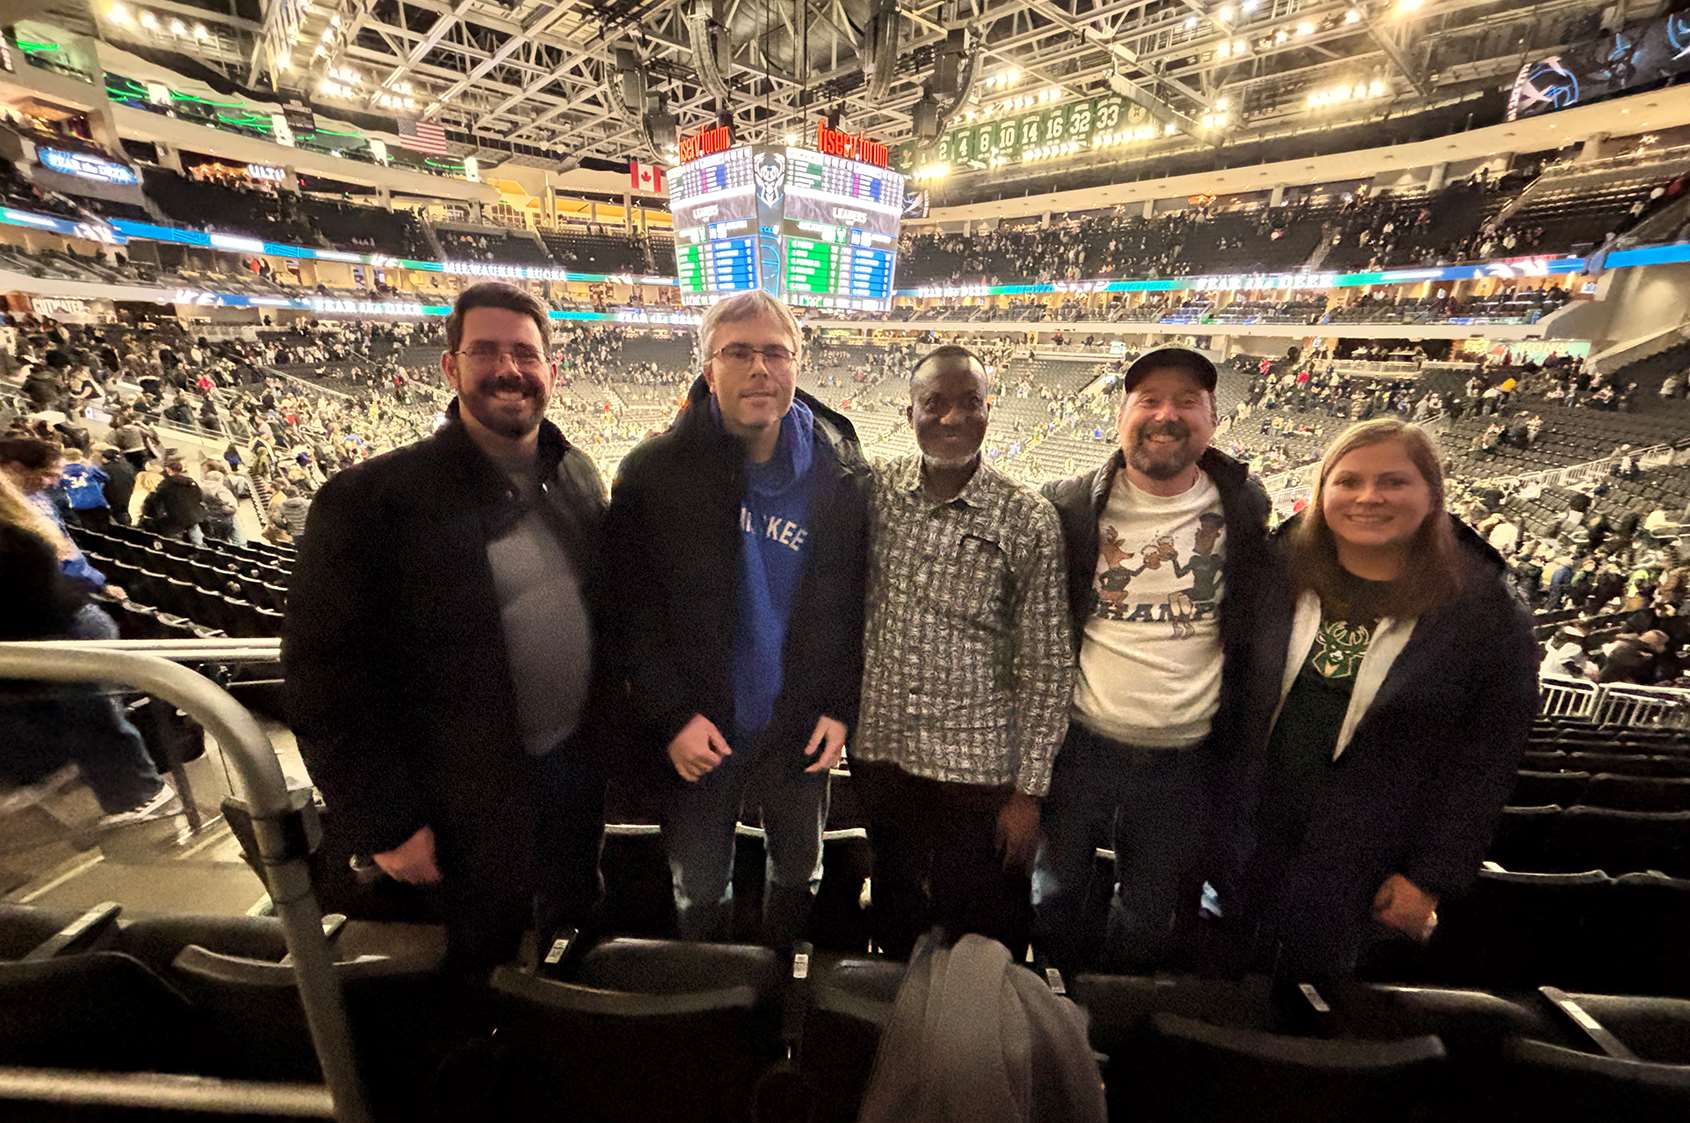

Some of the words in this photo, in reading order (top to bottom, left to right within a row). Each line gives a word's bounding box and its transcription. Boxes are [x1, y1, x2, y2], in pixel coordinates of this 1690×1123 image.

[1070, 111, 1091, 134] 32
[1097, 105, 1120, 127] 33
[701, 124, 731, 154] forum
[1000, 128, 1015, 147] 10
[1022, 124, 1038, 145] 14
[1046, 117, 1064, 140] 16
[859, 130, 889, 169] forum
[939, 142, 948, 160] 2
[959, 138, 968, 157] 4
[980, 133, 990, 152] 8
[443, 260, 522, 278] MILWAUKEE
[527, 266, 567, 281] BUCKS
[1279, 274, 1333, 289] DEER
